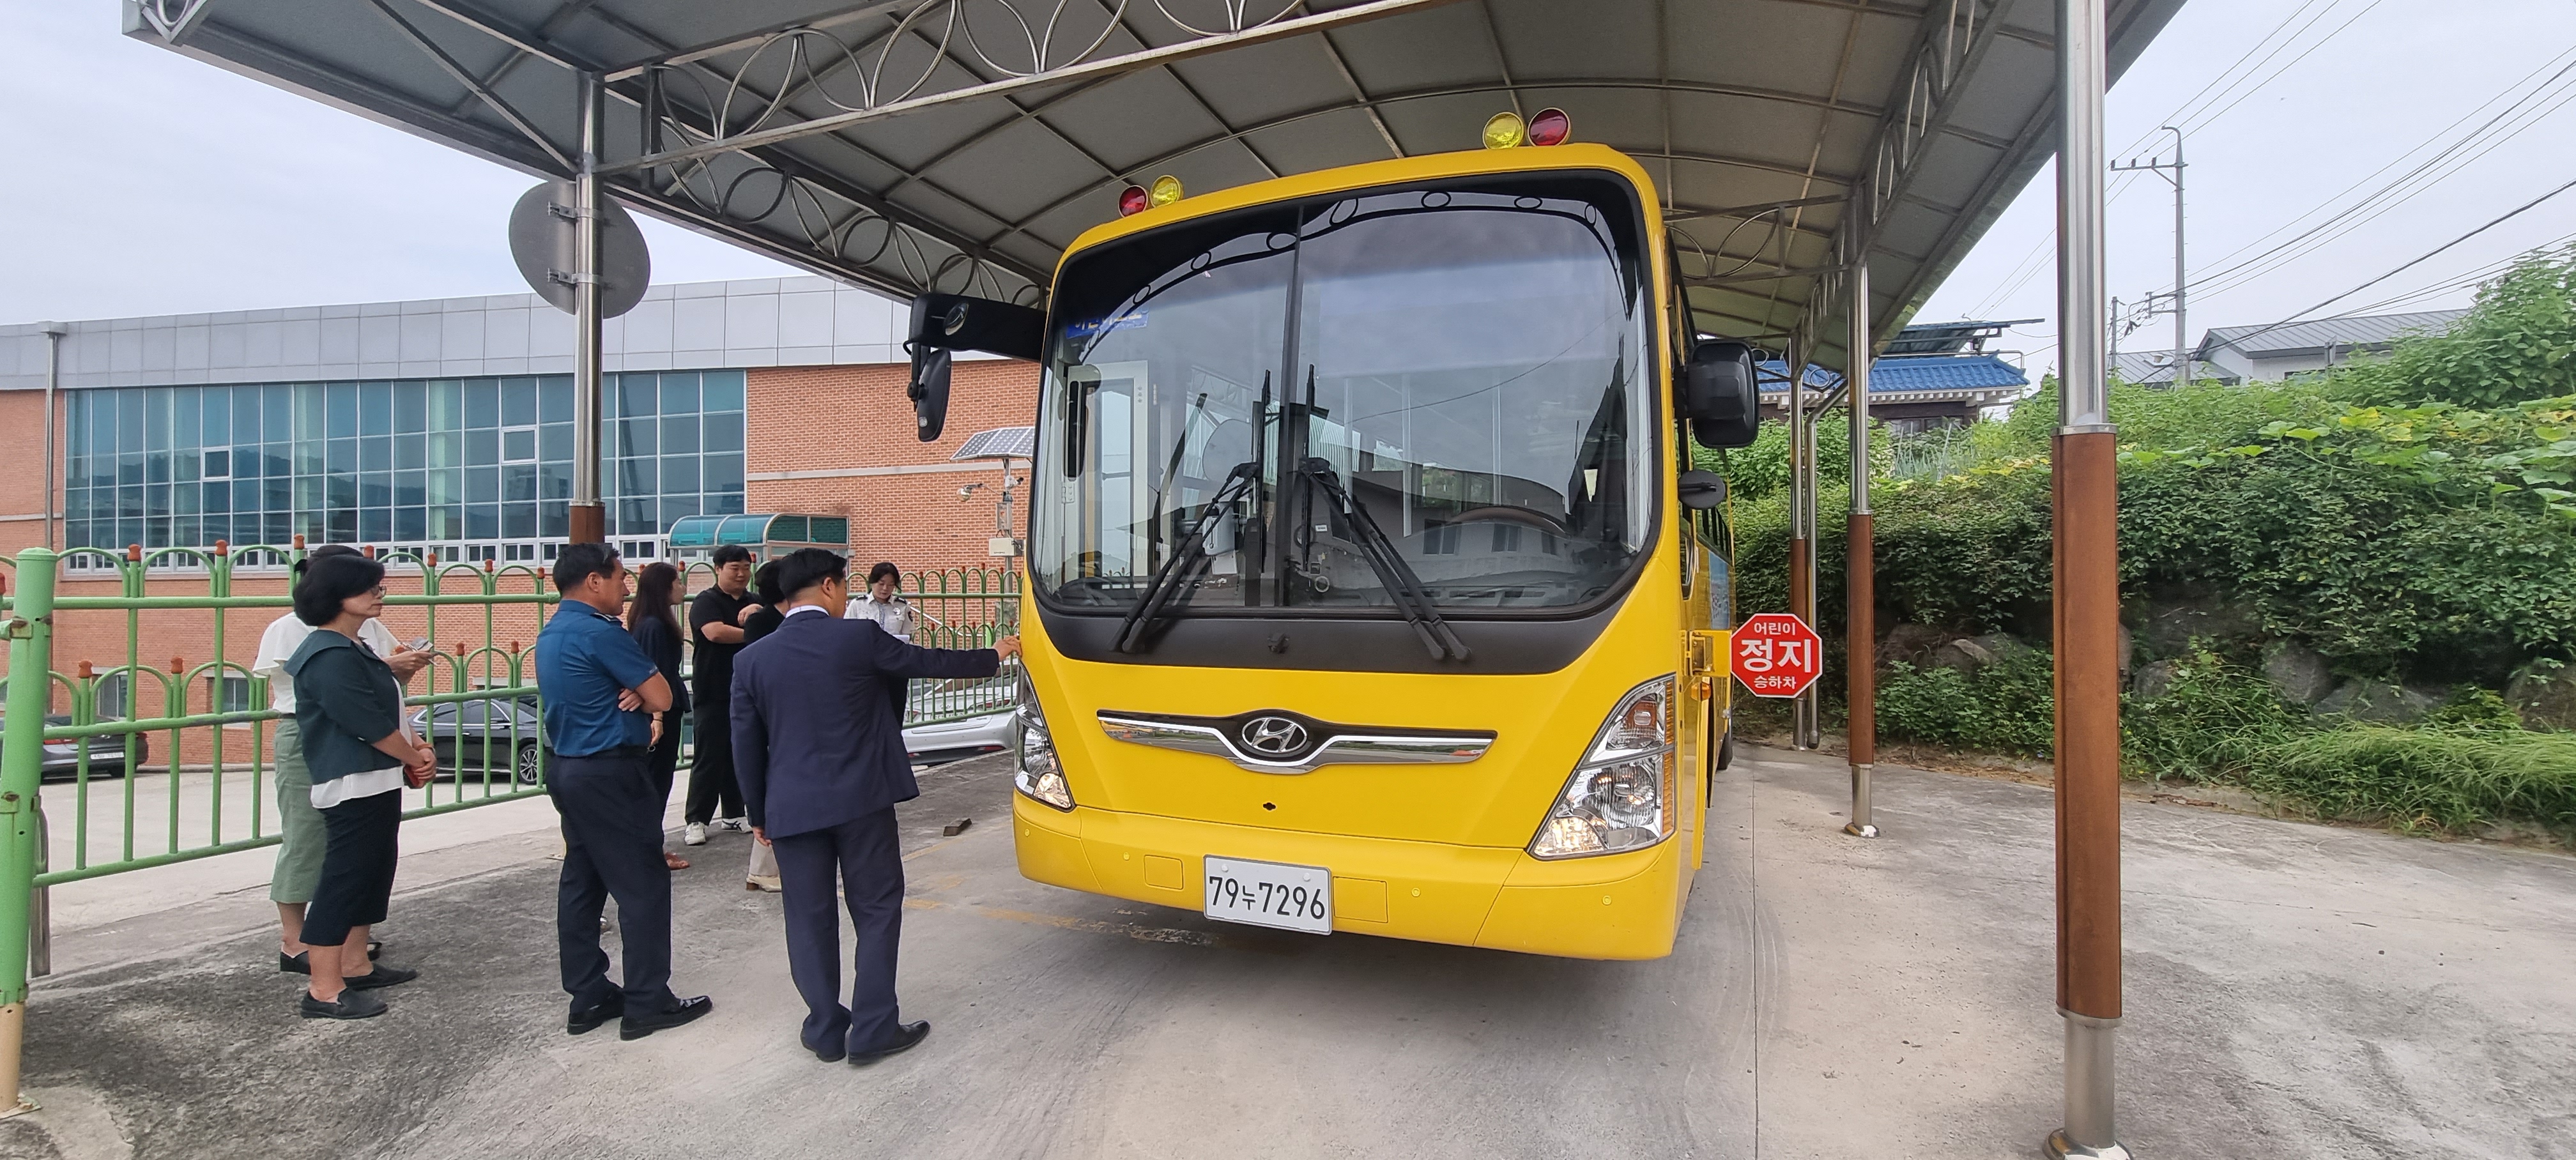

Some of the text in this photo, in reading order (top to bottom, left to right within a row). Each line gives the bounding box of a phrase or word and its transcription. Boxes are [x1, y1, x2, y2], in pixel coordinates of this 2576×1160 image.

[1754, 622, 1795, 636] 어린이
[1740, 638, 1811, 673] 정지
[1754, 675, 1797, 689] 승하차
[1209, 876, 1325, 920] 79누7296
